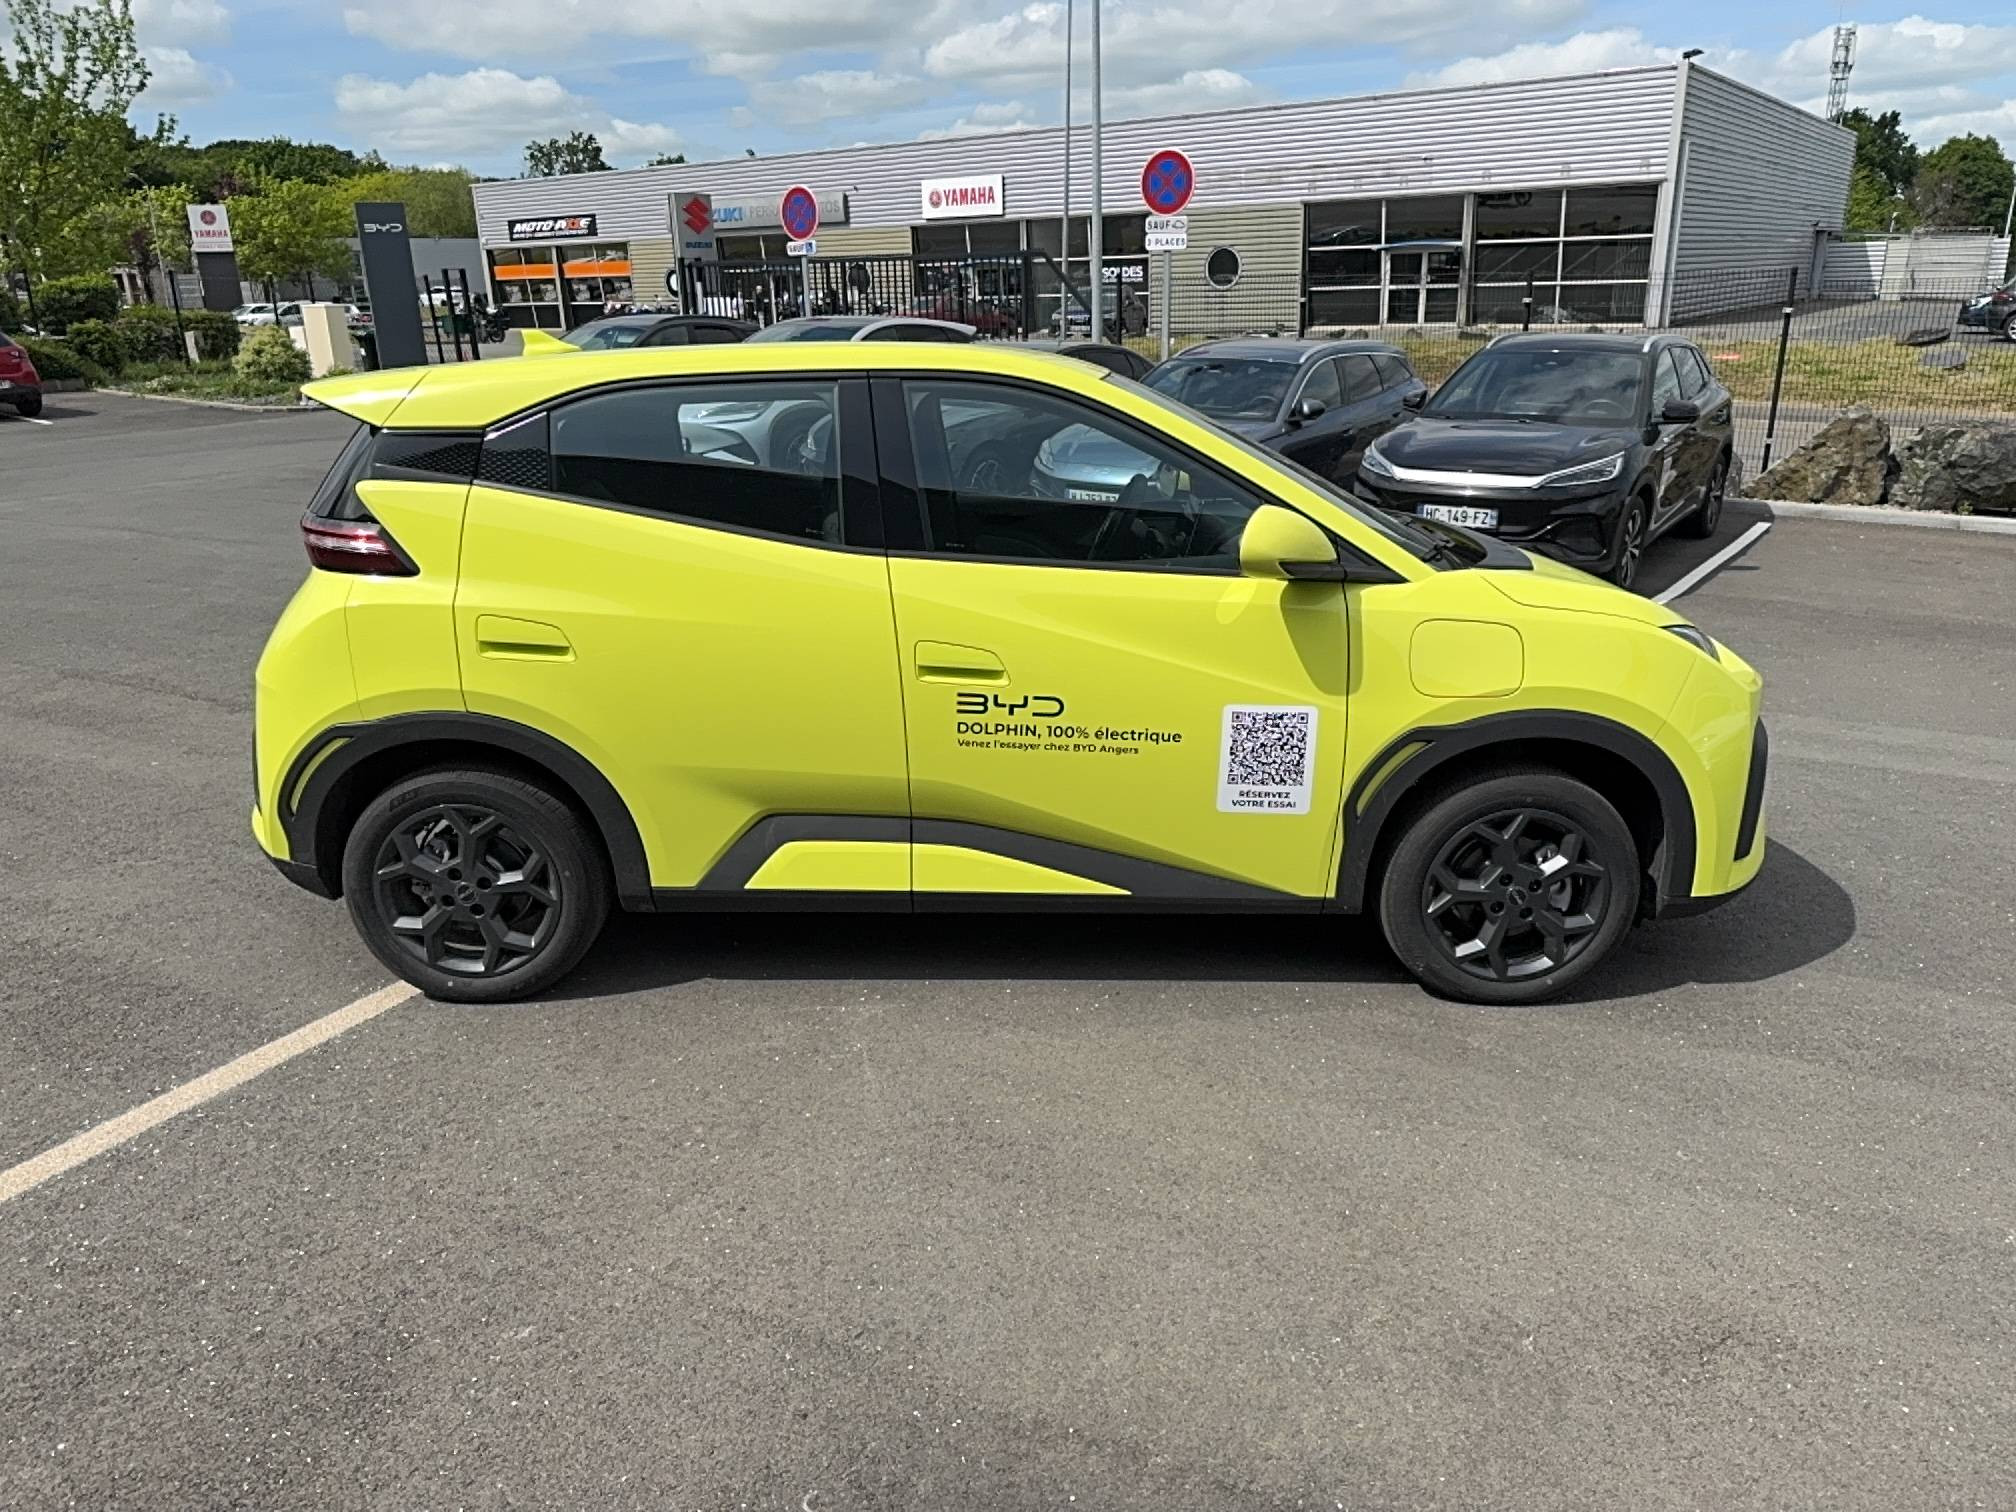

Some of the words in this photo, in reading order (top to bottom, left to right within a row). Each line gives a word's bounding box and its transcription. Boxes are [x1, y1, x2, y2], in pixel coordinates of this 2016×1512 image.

[943, 185, 996, 207] YAMAHA
[712, 207, 743, 223] ZUKI
[363, 223, 403, 233] BYD
[513, 219, 554, 234] MOTO
[1147, 220, 1170, 230] SAUF
[194, 229, 229, 238] YAMAHA
[1155, 237, 1185, 247] PLACES
[1425, 506, 1489, 525] HC-149-FZ
[956, 692, 1065, 718] BYD
[957, 722, 1041, 740] DOLPHIN,
[1046, 725, 1090, 740] 100%
[1094, 726, 1182, 745] électrique
[957, 739, 991, 748] Venez
[994, 739, 1041, 752] l'essayer
[1044, 742, 1070, 752] chez
[1073, 743, 1097, 753] BYD
[1099, 744, 1139, 755] Angers
[1239, 789, 1291, 799] RÉSERVEZ
[1231, 799, 1265, 808] VOTRE
[1267, 800, 1297, 809] ESSAI
